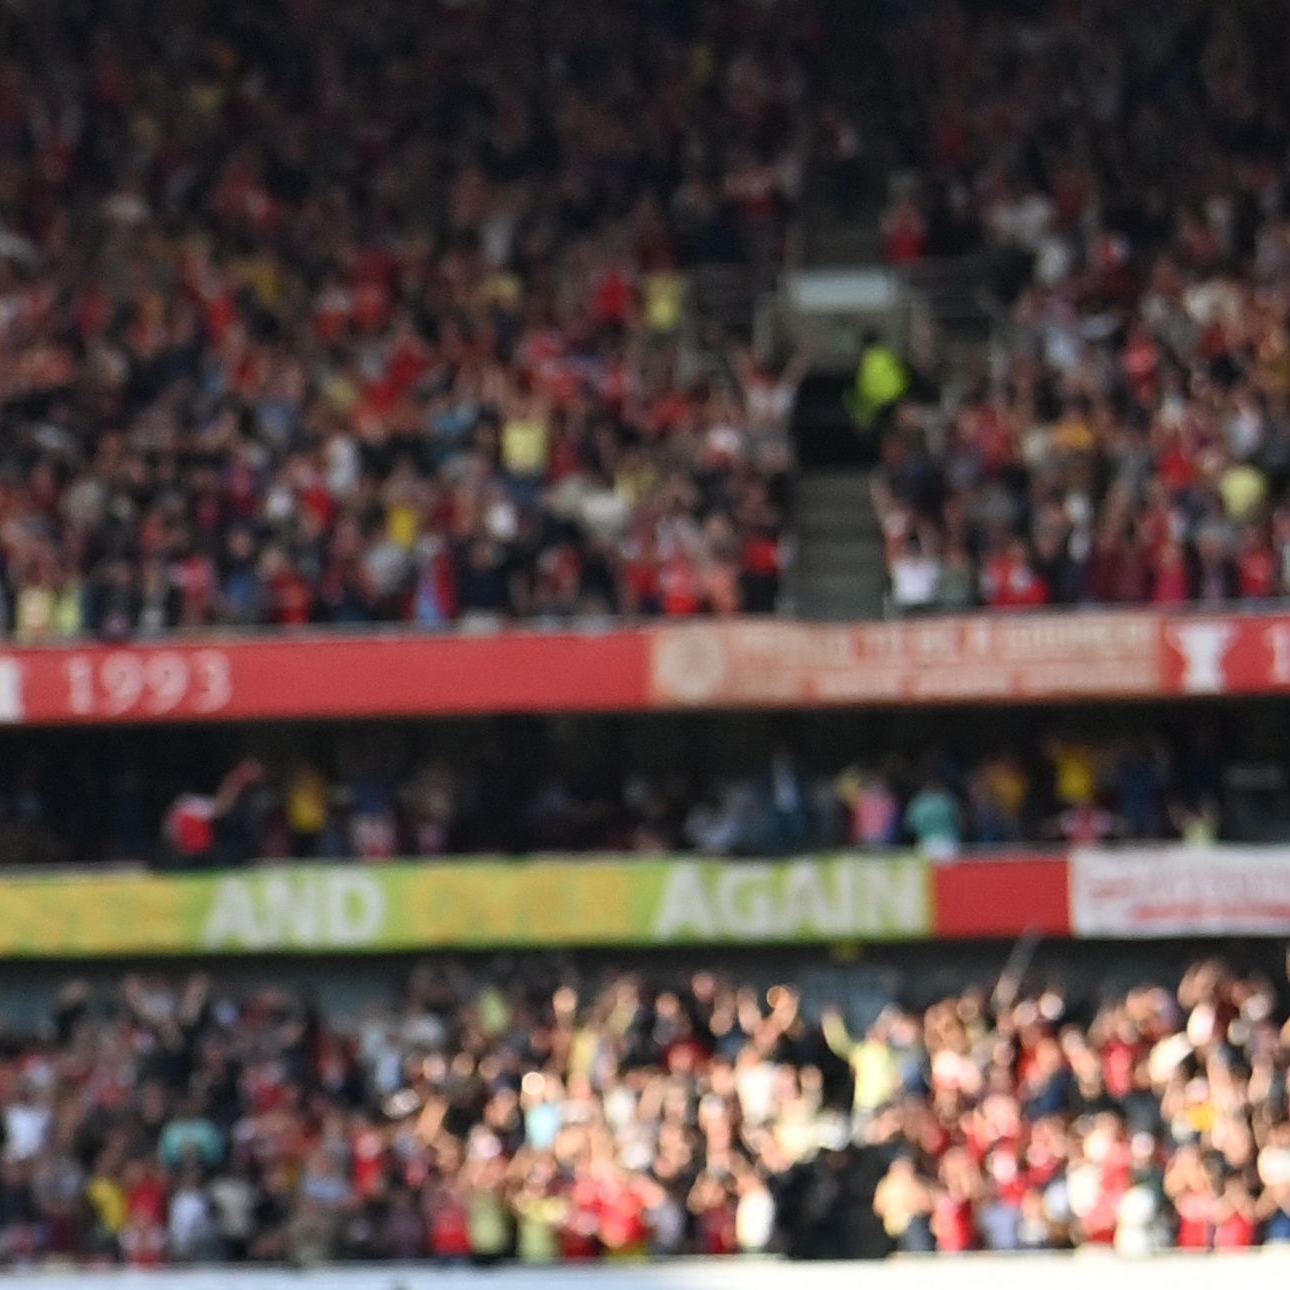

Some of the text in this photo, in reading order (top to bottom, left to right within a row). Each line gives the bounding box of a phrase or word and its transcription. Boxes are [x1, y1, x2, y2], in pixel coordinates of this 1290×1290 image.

[62, 650, 233, 716] 1993
[202, 867, 386, 952] AND
[651, 858, 927, 944] AGAIN
